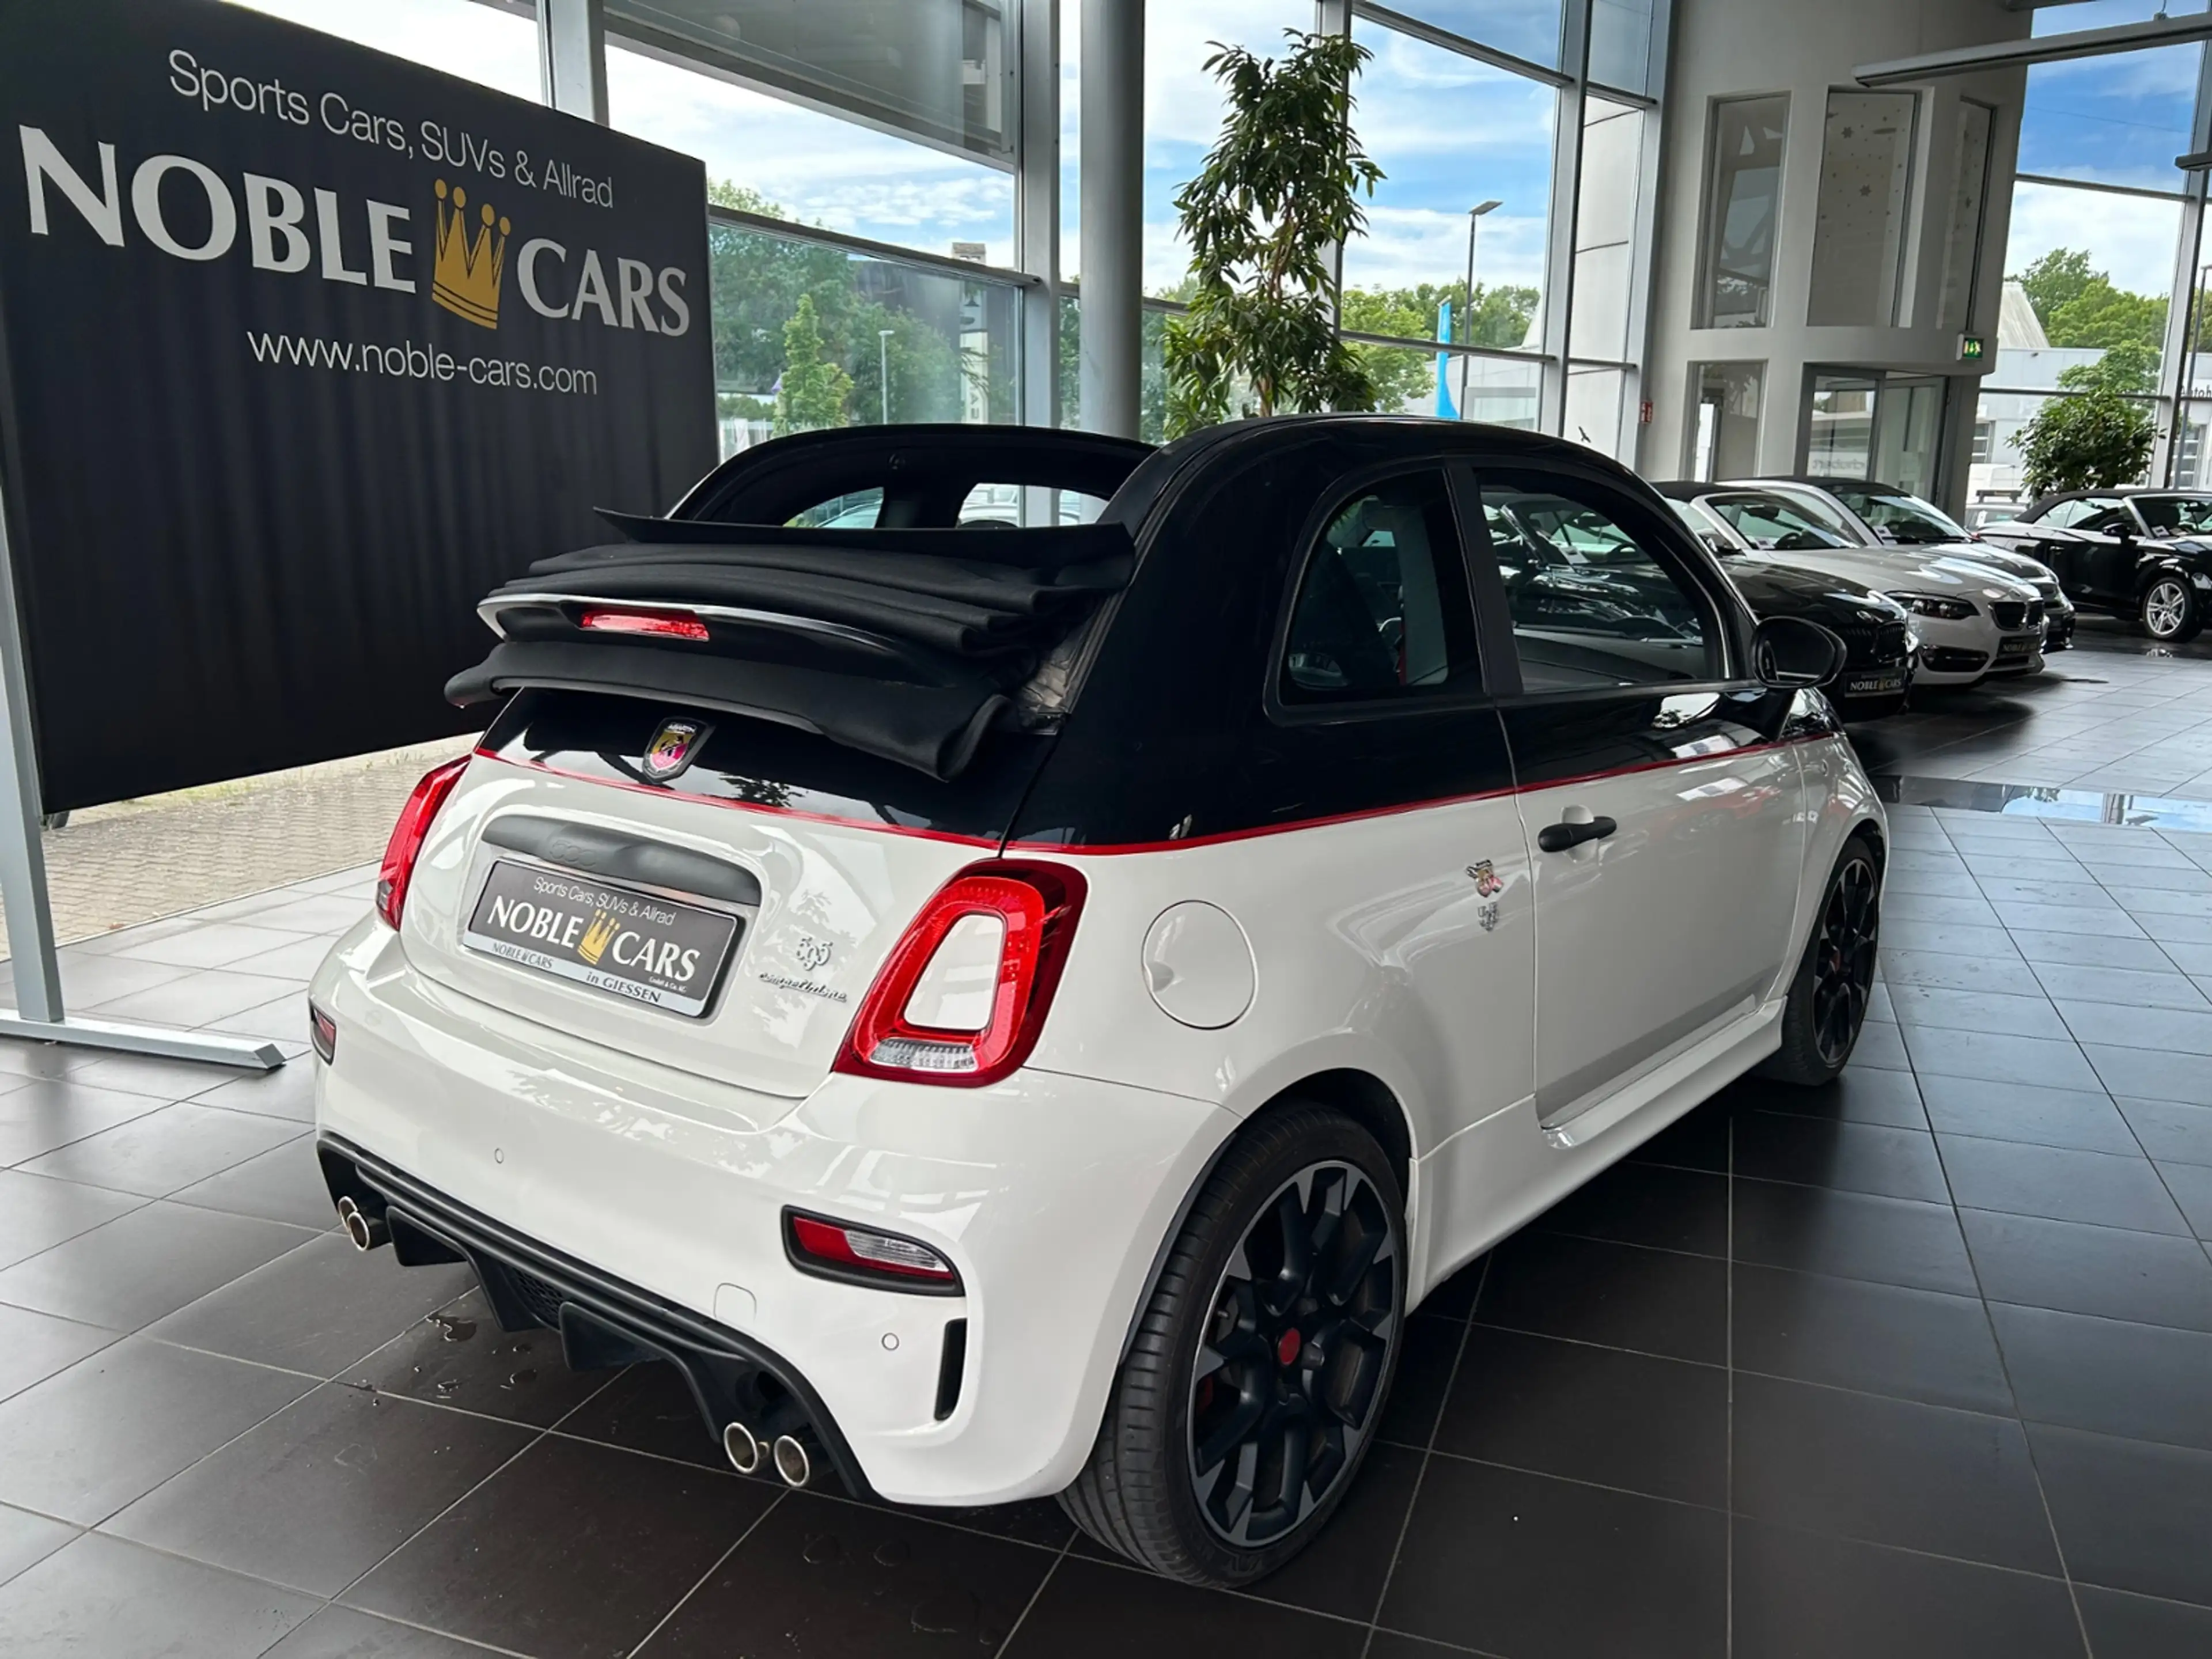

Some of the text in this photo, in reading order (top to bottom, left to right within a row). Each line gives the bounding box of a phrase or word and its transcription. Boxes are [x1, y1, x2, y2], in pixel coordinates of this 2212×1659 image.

[168, 48, 615, 210] Sports Cars, SUVs & Allrad
[18, 123, 691, 337] NOBLE CARS
[247, 330, 598, 396] www.noble-cars.com
[533, 876, 677, 926] Sports Cars, SUVs & Allrad
[487, 895, 702, 982] NOBLE CARS
[492, 942, 554, 968] NOBLE CARS
[586, 971, 662, 1003] in GIESSEN
